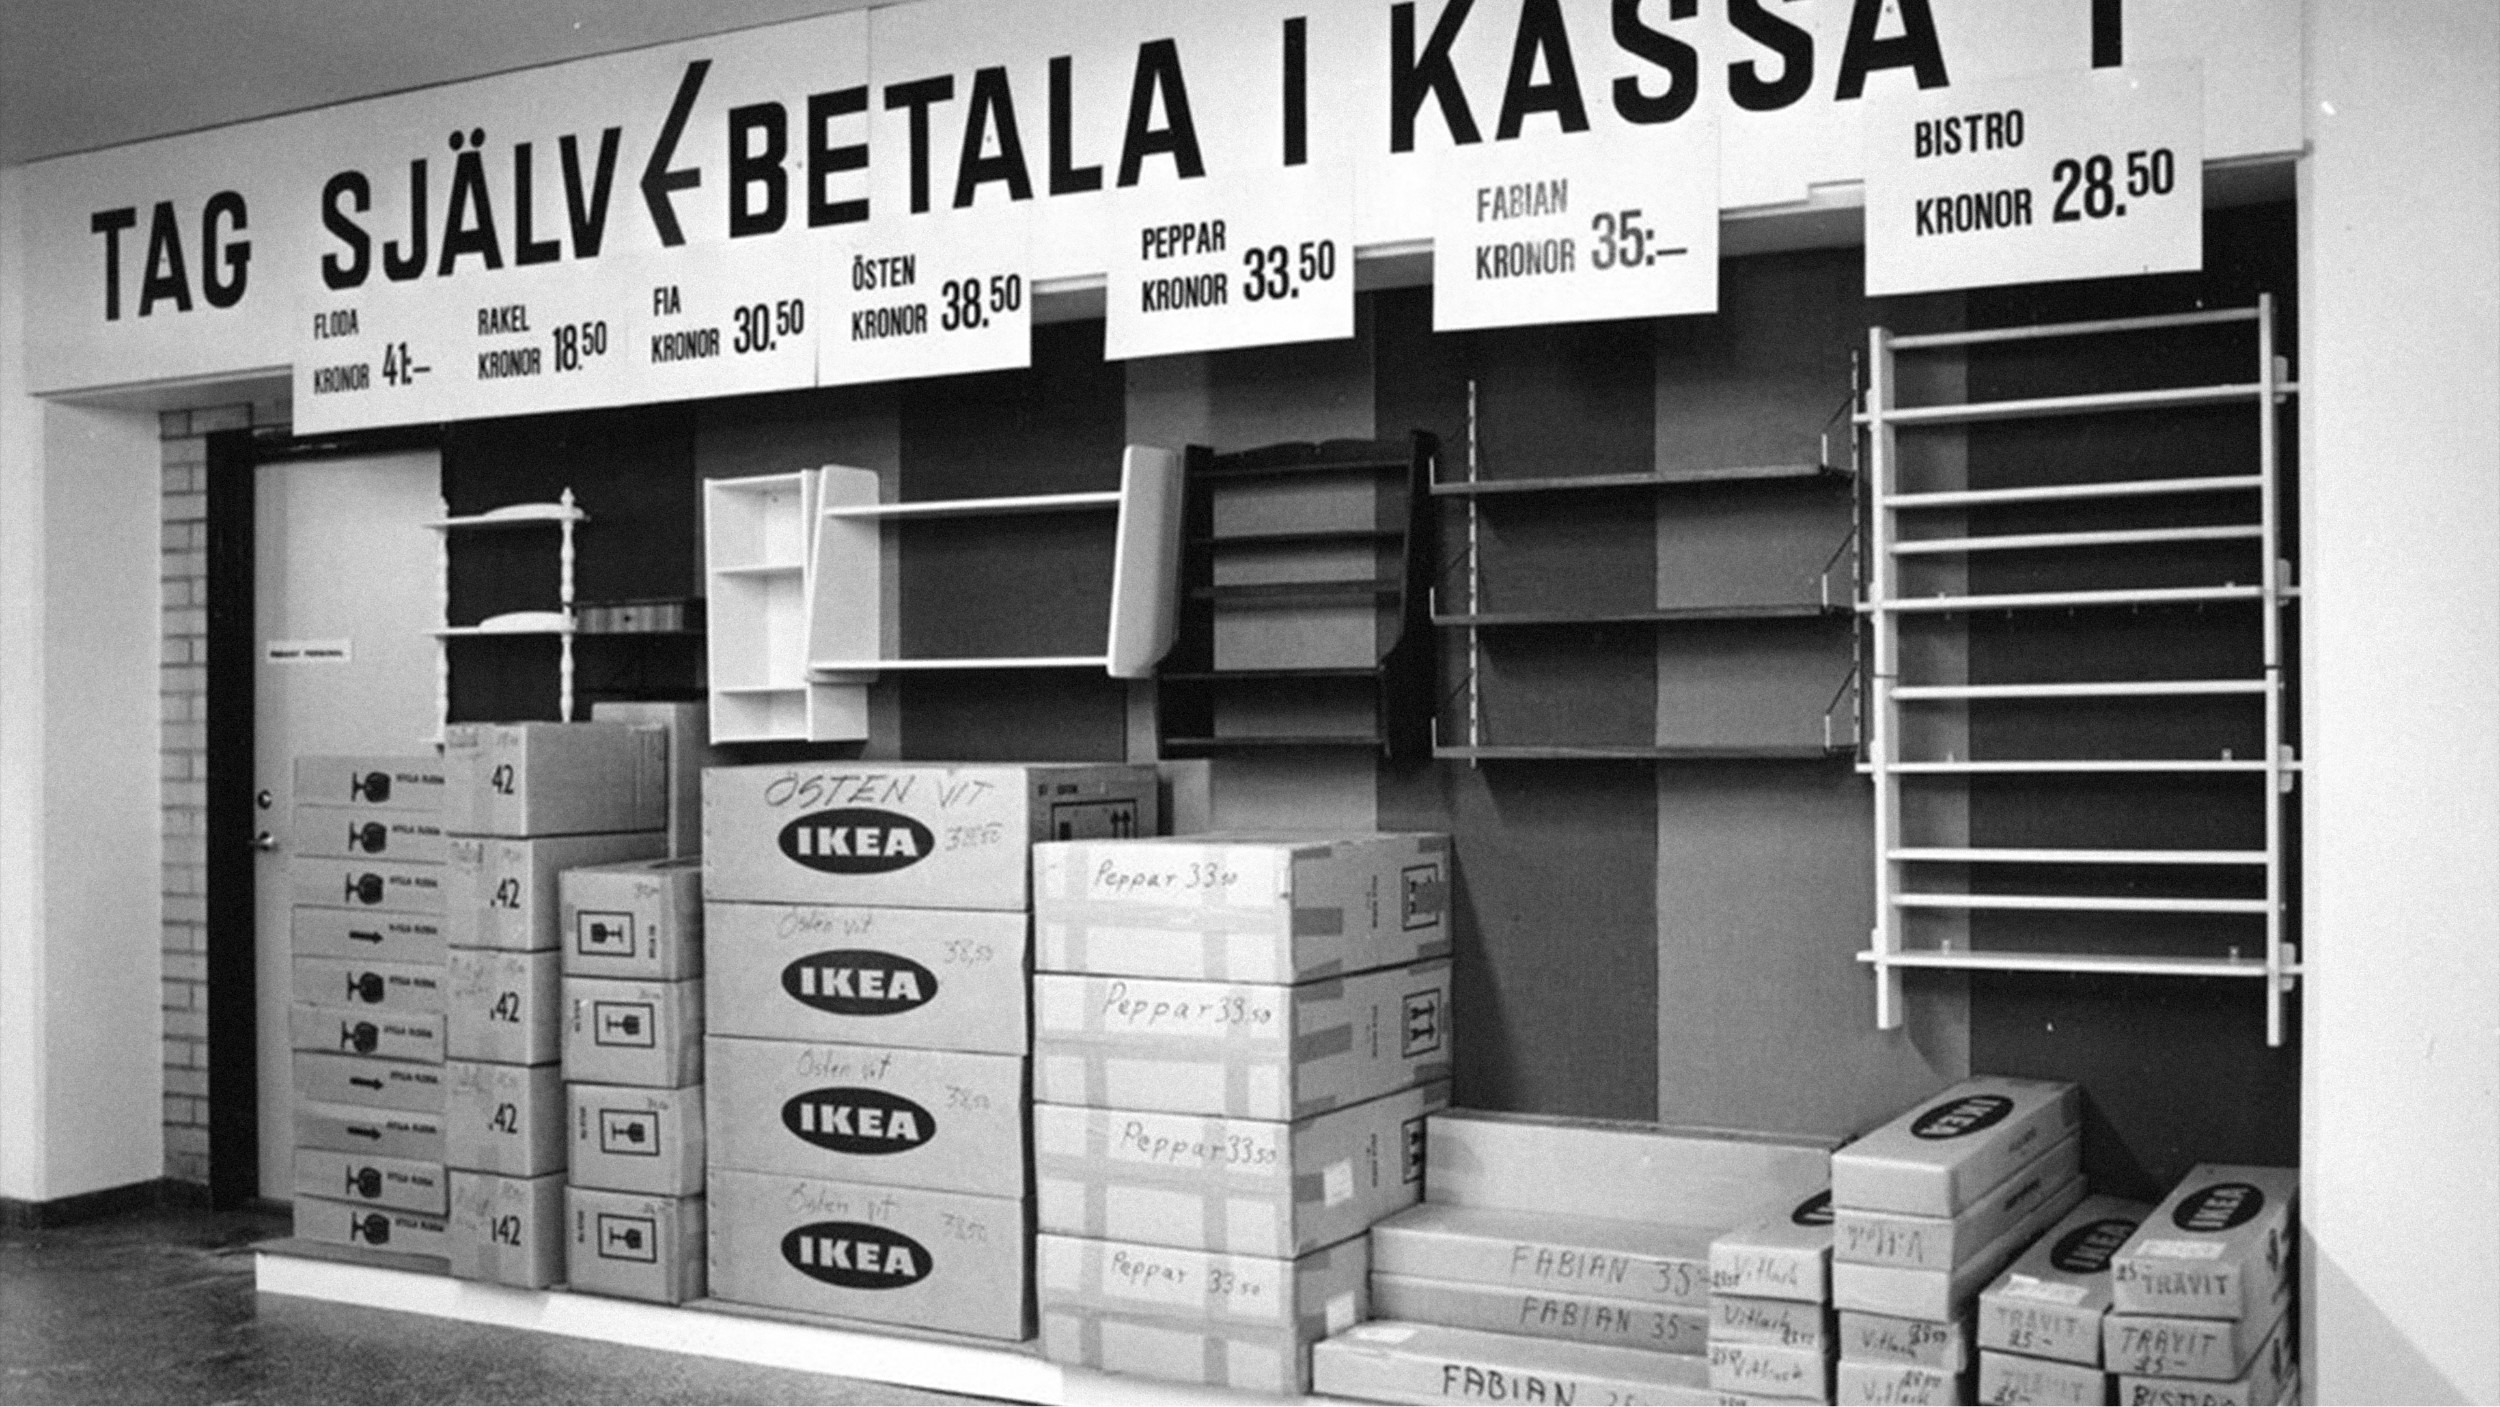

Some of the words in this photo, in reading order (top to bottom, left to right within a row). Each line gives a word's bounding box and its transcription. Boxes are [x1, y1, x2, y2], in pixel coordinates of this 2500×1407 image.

[1915, 109, 2025, 159] BISTRO
[91, 191, 251, 321] TAG
[321, 127, 622, 291] SJÄLV
[728, 38, 1207, 238] BETALA
[1283, 16, 1307, 167] I
[1476, 178, 1568, 224] FABIAN
[1916, 188, 2032, 237] KRONOR
[2052, 147, 2175, 224] 28.50
[1142, 220, 1226, 261] PEPPAR
[1475, 237, 1576, 281] KRONOR
[852, 254, 916, 291] ÖSTEN
[1141, 274, 1228, 313] KRONOR
[1243, 240, 1336, 303] 33.50
[654, 287, 681, 316] FIA
[851, 305, 928, 344] KRONOR
[940, 274, 1021, 332] 38.50
[314, 309, 359, 340] FLODA
[478, 305, 530, 337] RAKEL
[651, 329, 720, 363] KRONOR
[733, 299, 804, 353] 30.50
[314, 363, 369, 395] KRONOR
[478, 350, 541, 381] KRONOR
[491, 764, 515, 794] 42
[765, 772, 915, 809] ÖSTEN
[938, 780, 994, 808] VIT
[797, 828, 918, 857] IKEA
[1094, 859, 1178, 891] Peppar
[801, 967, 921, 1000] IKEA
[1102, 981, 1211, 1026] Peppar
[801, 1103, 920, 1141] IKEA
[1120, 1121, 1226, 1162] Peppar
[491, 1215, 521, 1246] 142
[800, 1236, 917, 1277] IKEA
[1111, 1251, 1186, 1286] Peppar
[1510, 1246, 1630, 1283] FABIAN
[1519, 1296, 1631, 1333] FABIAN
[1442, 1364, 1577, 1406] FABIAN
